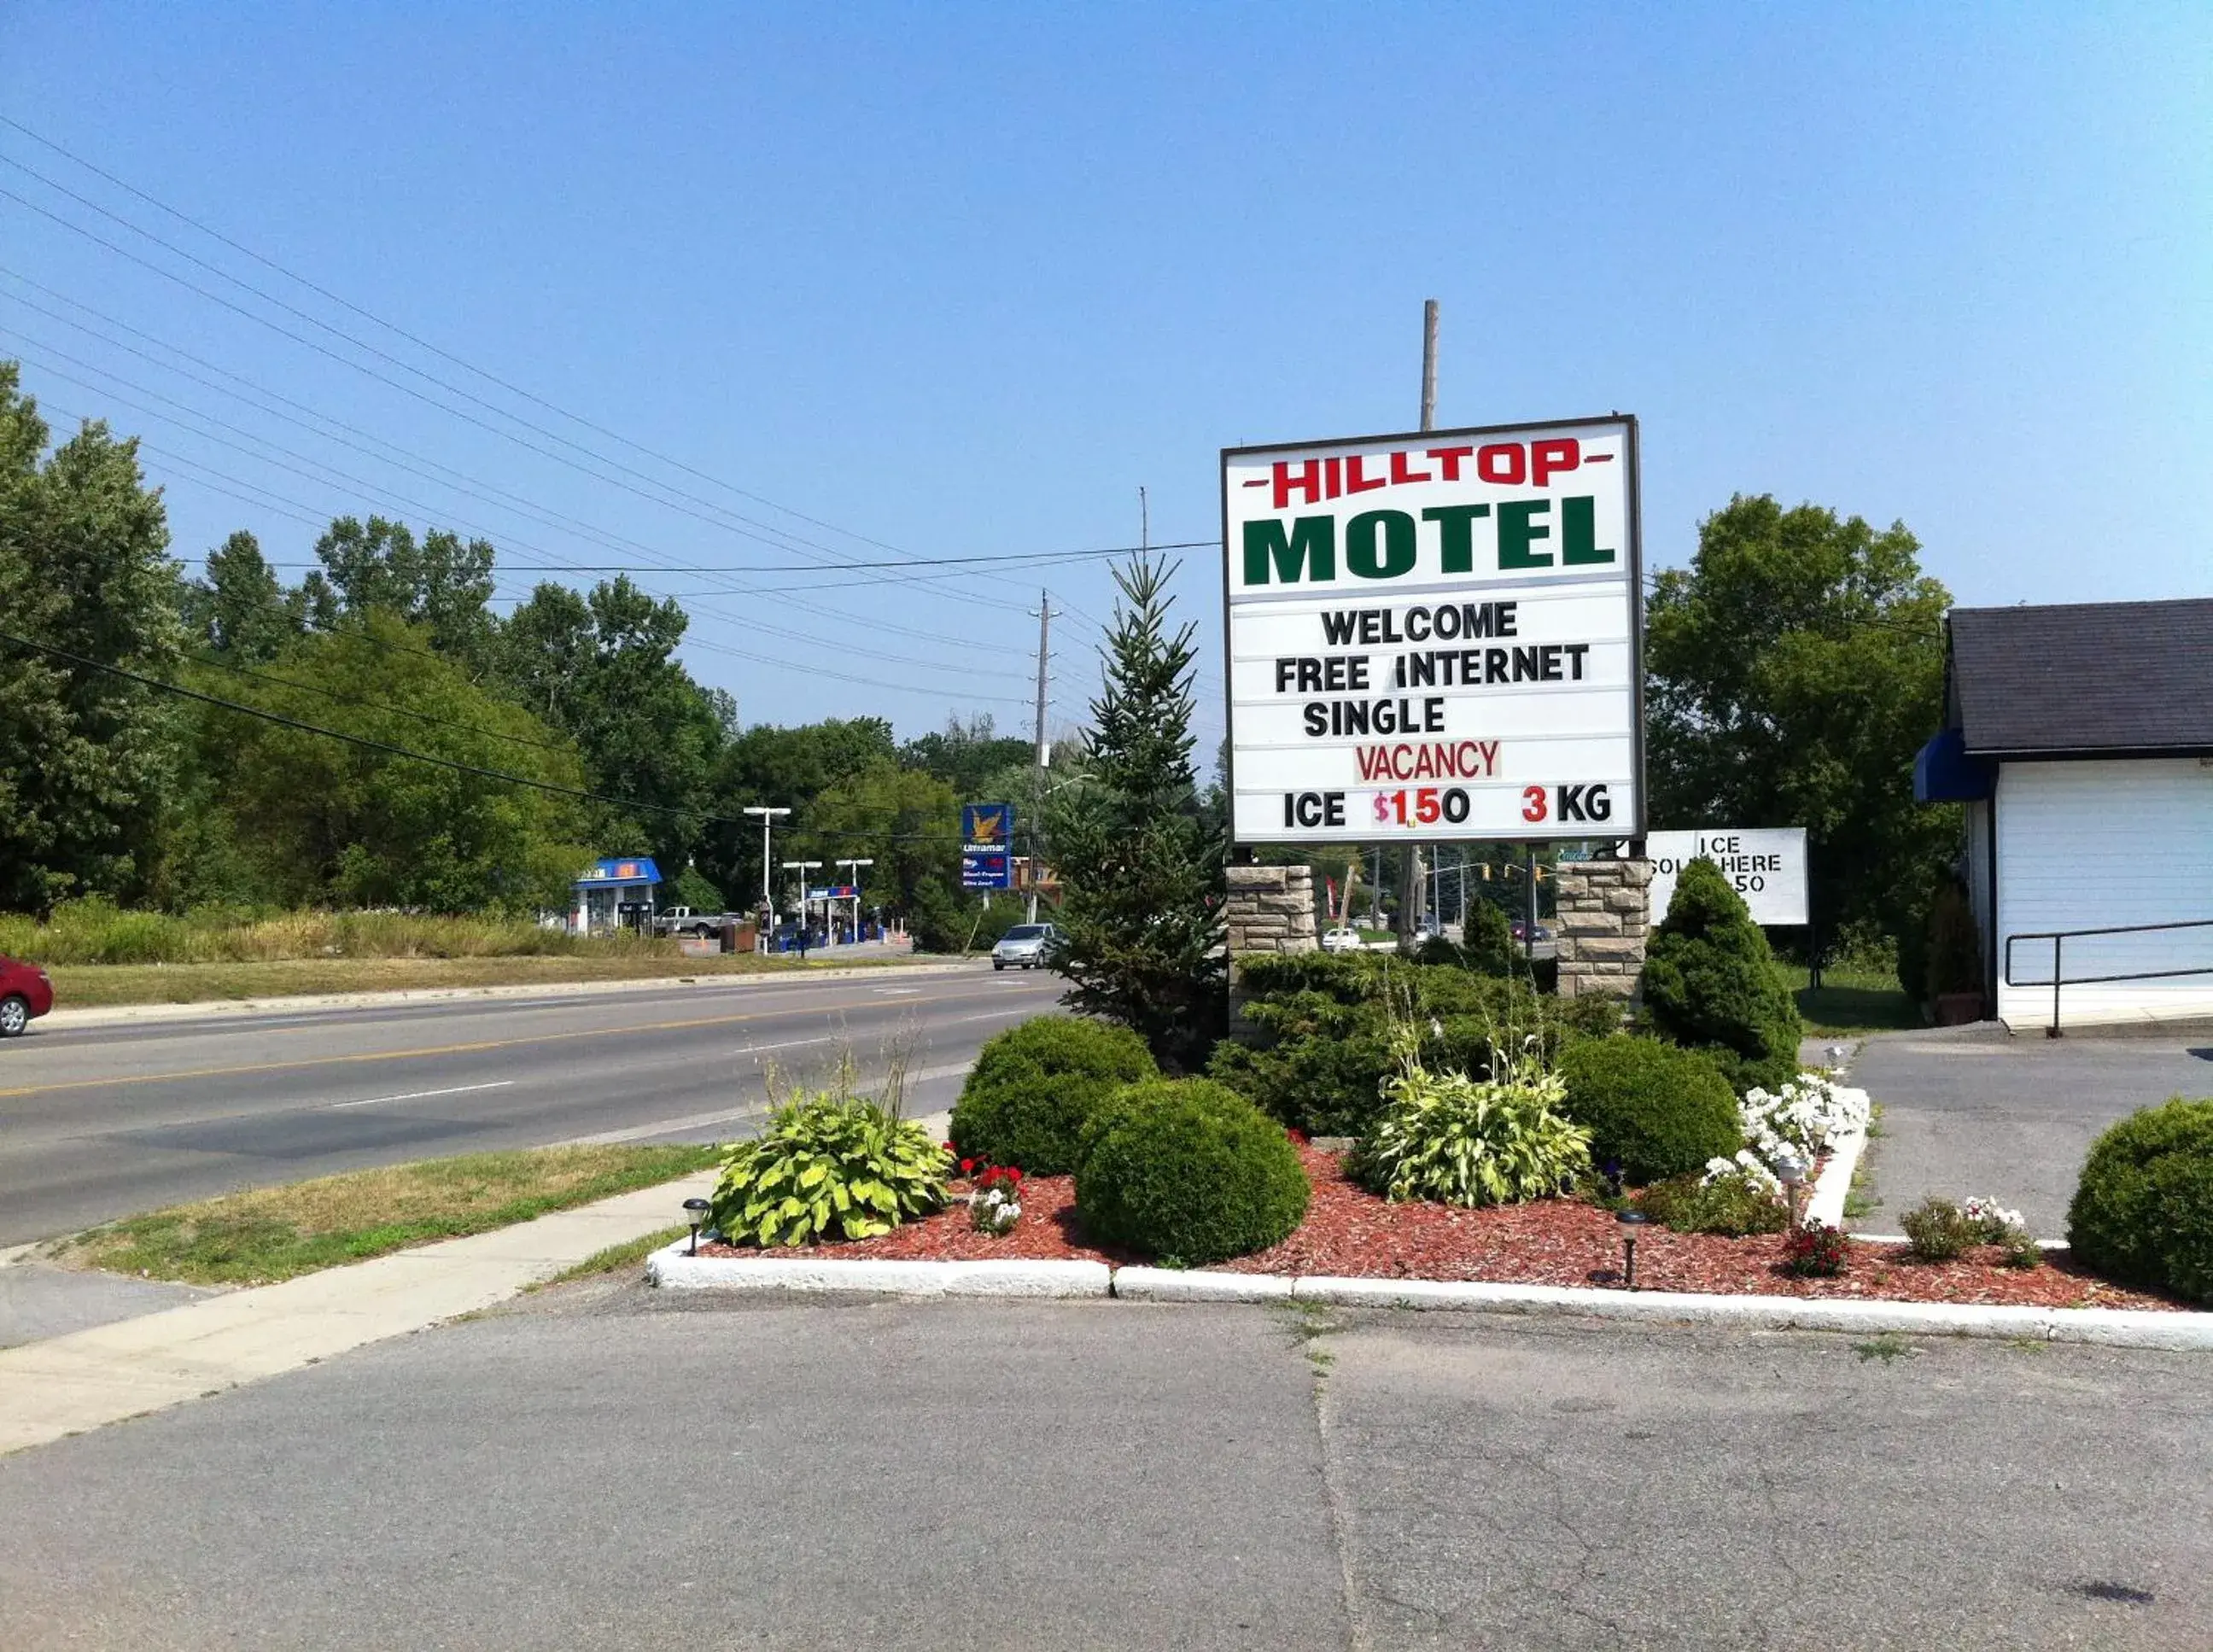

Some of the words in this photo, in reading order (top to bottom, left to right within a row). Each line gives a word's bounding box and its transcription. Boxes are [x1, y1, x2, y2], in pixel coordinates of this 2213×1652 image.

[1243, 495, 1615, 586] MOTEL
[1320, 602, 1517, 645] WELCOME
[1276, 655, 1369, 693] FREE
[1395, 644, 1590, 688] INTERNET
[1304, 698, 1445, 737] SINGLE
[1356, 740, 1499, 780] VACANCY
[1284, 791, 1346, 827] ICE
[1522, 785, 1549, 822] 3
[1557, 784, 1611, 821] KG
[1701, 837, 1740, 854] ICE
[1721, 855, 1782, 873] HERE
